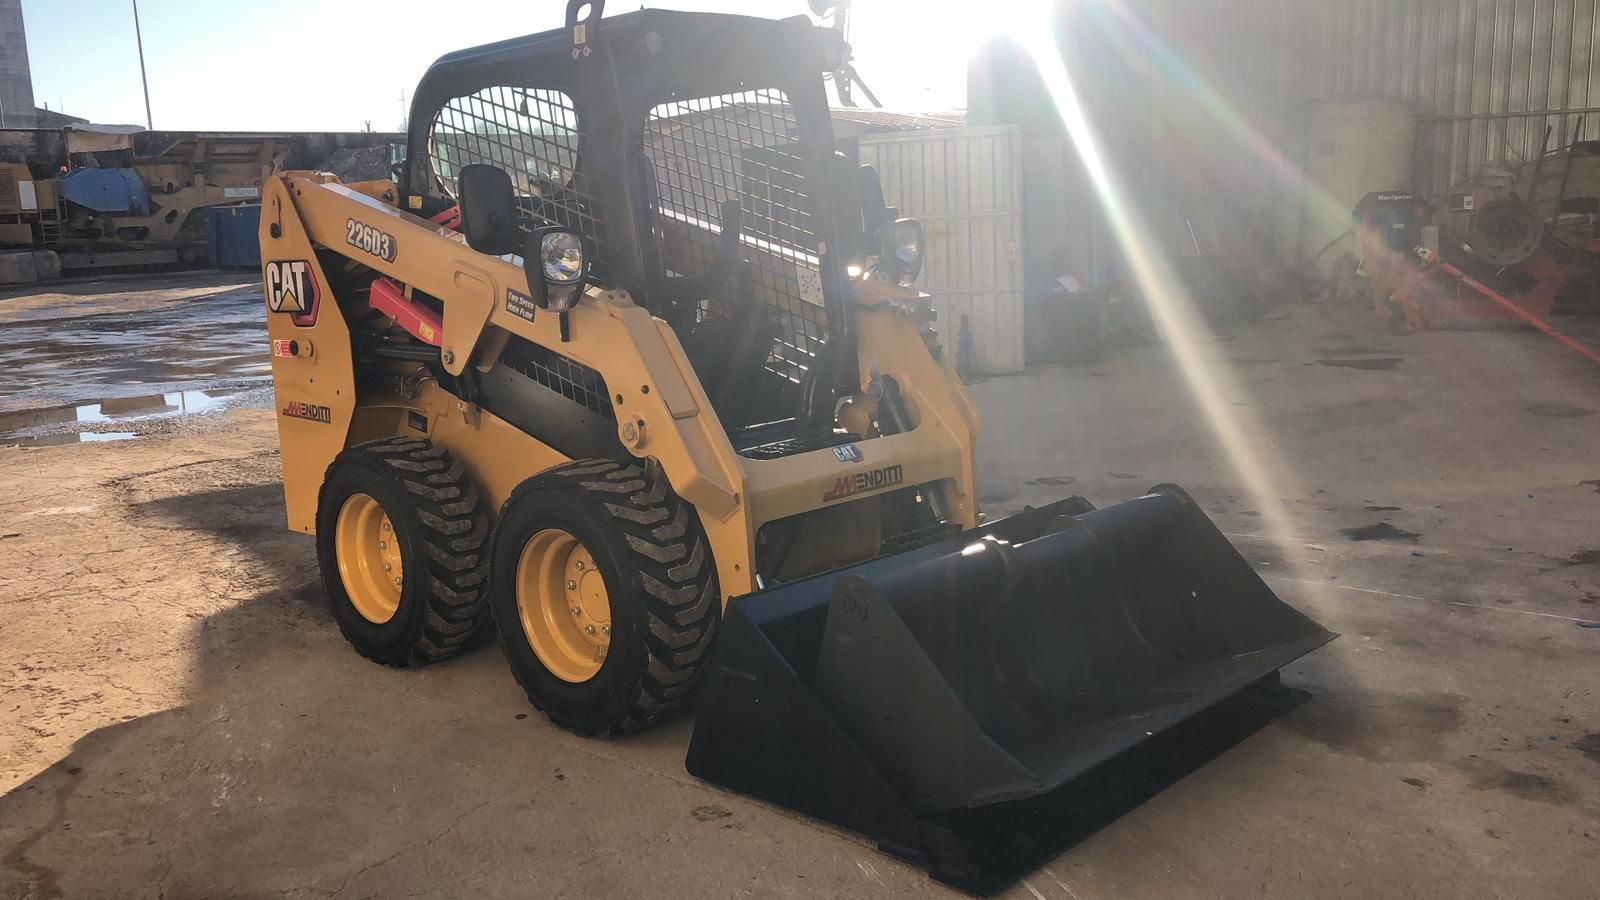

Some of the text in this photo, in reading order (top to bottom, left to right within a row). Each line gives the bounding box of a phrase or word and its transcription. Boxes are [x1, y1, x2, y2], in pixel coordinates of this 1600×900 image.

[1377, 193, 1413, 202] Navigator
[346, 219, 391, 261] 226D3
[266, 261, 305, 312] CAT
[283, 401, 332, 423] MENDITTI
[833, 445, 859, 461] CAT
[823, 465, 903, 501] MENDITTI
